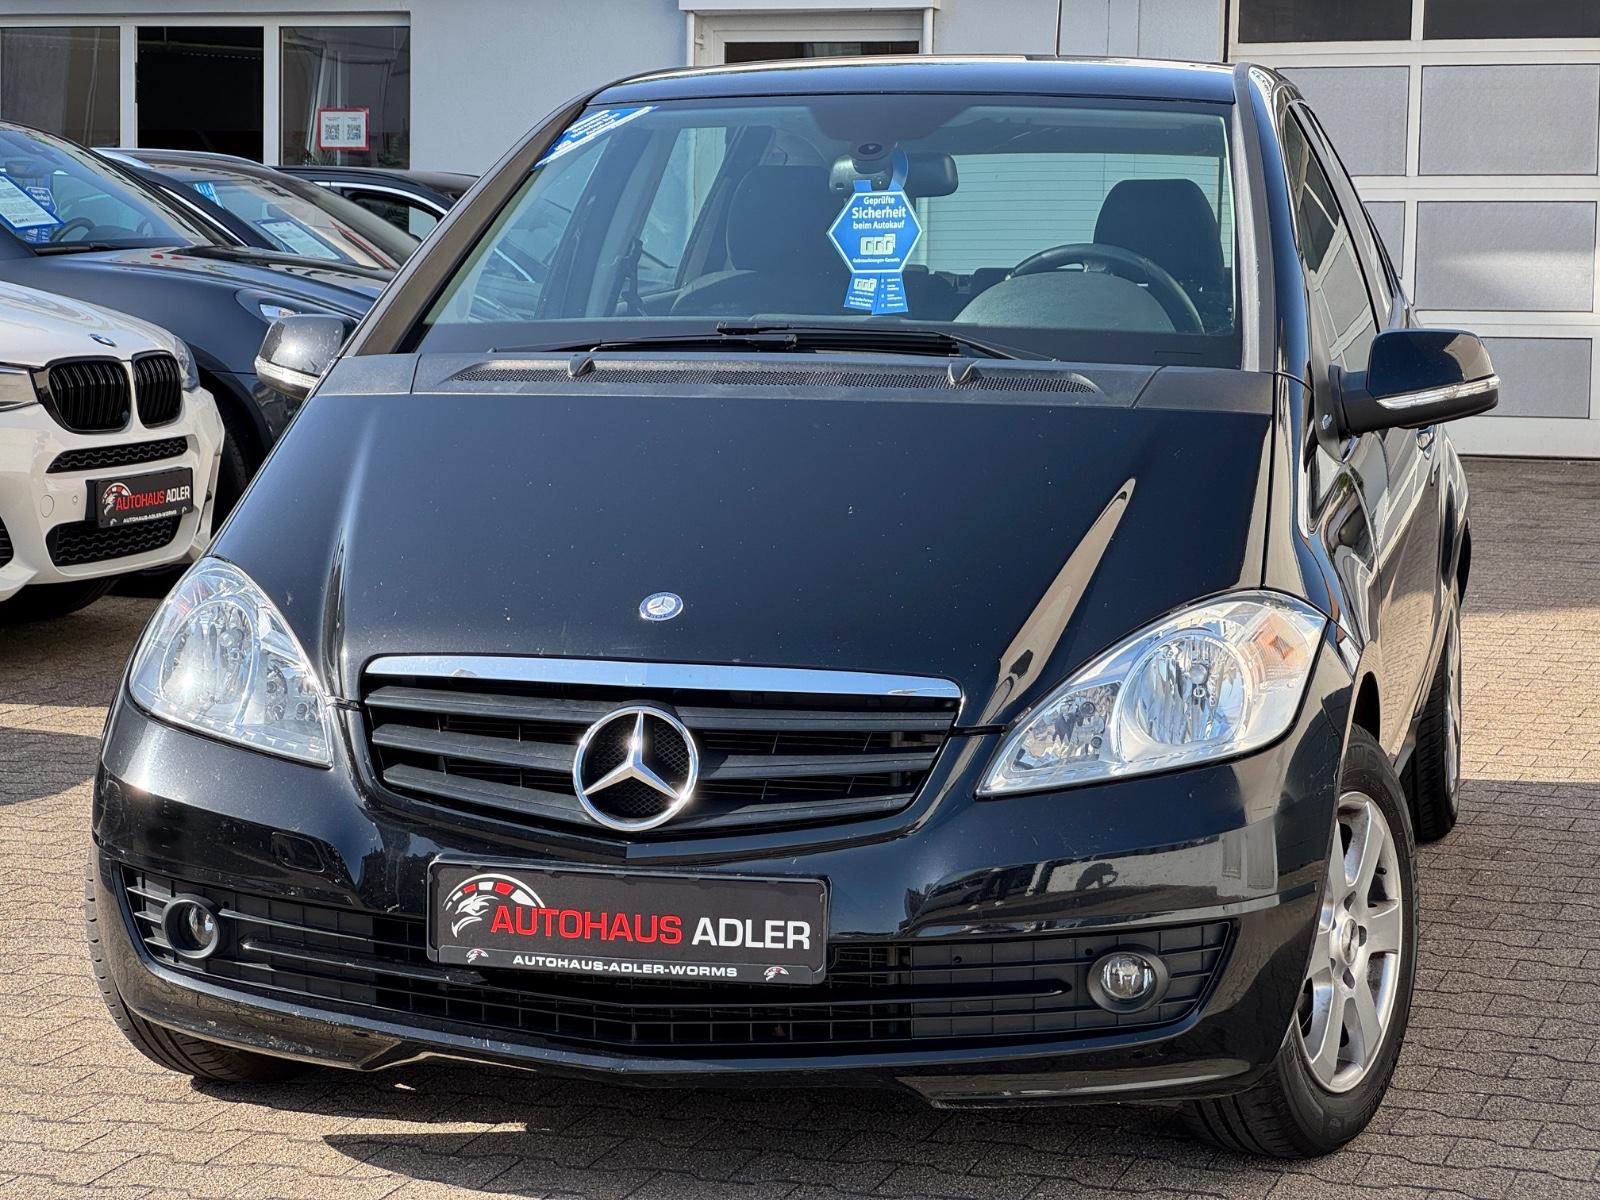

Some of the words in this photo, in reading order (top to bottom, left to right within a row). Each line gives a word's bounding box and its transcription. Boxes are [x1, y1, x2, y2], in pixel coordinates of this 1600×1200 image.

[863, 196, 895, 206] Geprüfte
[852, 206, 906, 219] Sicherheit
[853, 221, 872, 230] beim
[873, 220, 905, 229] Autokauf
[115, 491, 165, 511] AUTOHAUS
[166, 485, 190, 503] ADLER
[490, 905, 683, 945] AUTOHAUS
[691, 917, 811, 950] ADLER
[512, 954, 738, 978] AUTOHAUS-ADLER-WORMS
